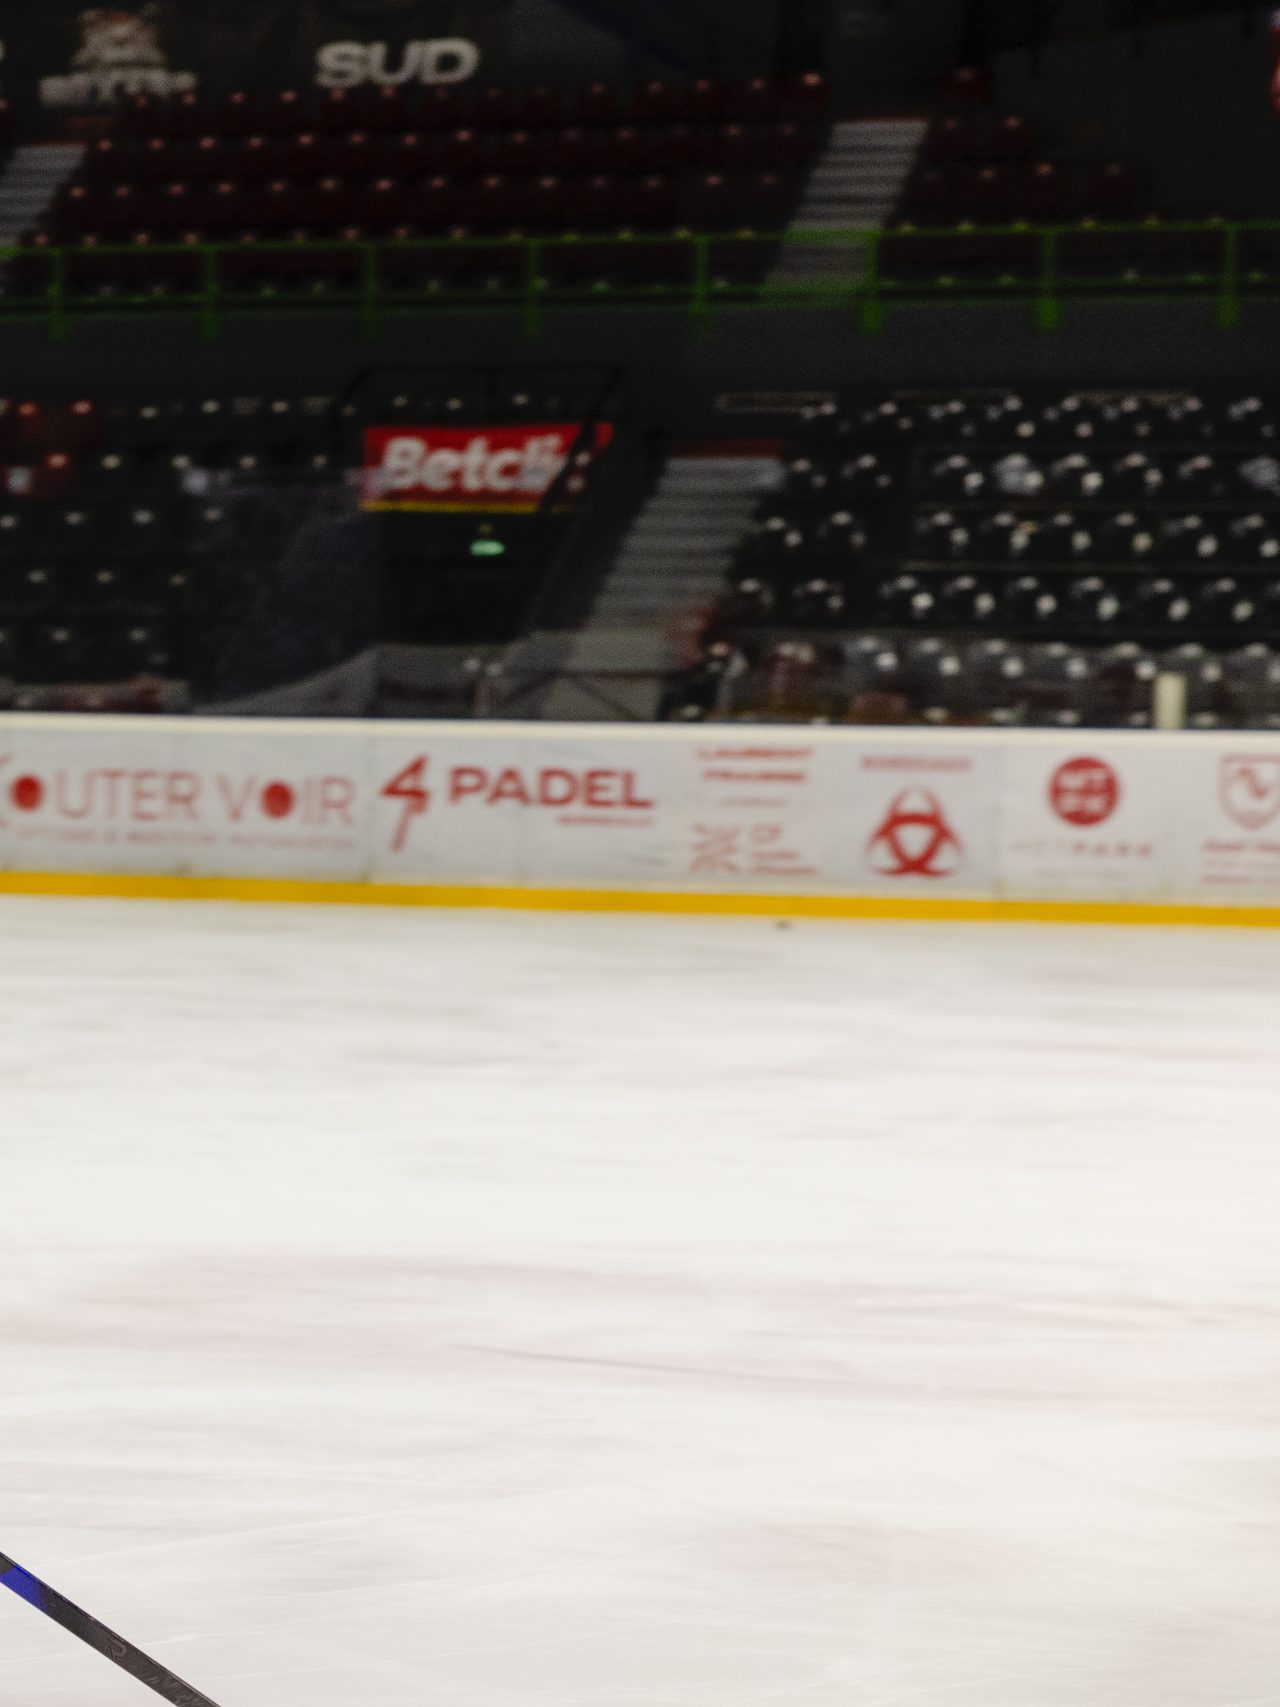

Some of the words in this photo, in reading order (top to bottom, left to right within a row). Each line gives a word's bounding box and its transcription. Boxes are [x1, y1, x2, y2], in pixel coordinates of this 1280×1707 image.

[316, 38, 481, 89] SUD
[214, 773, 357, 826] VOIR
[448, 766, 655, 809] PADEL
